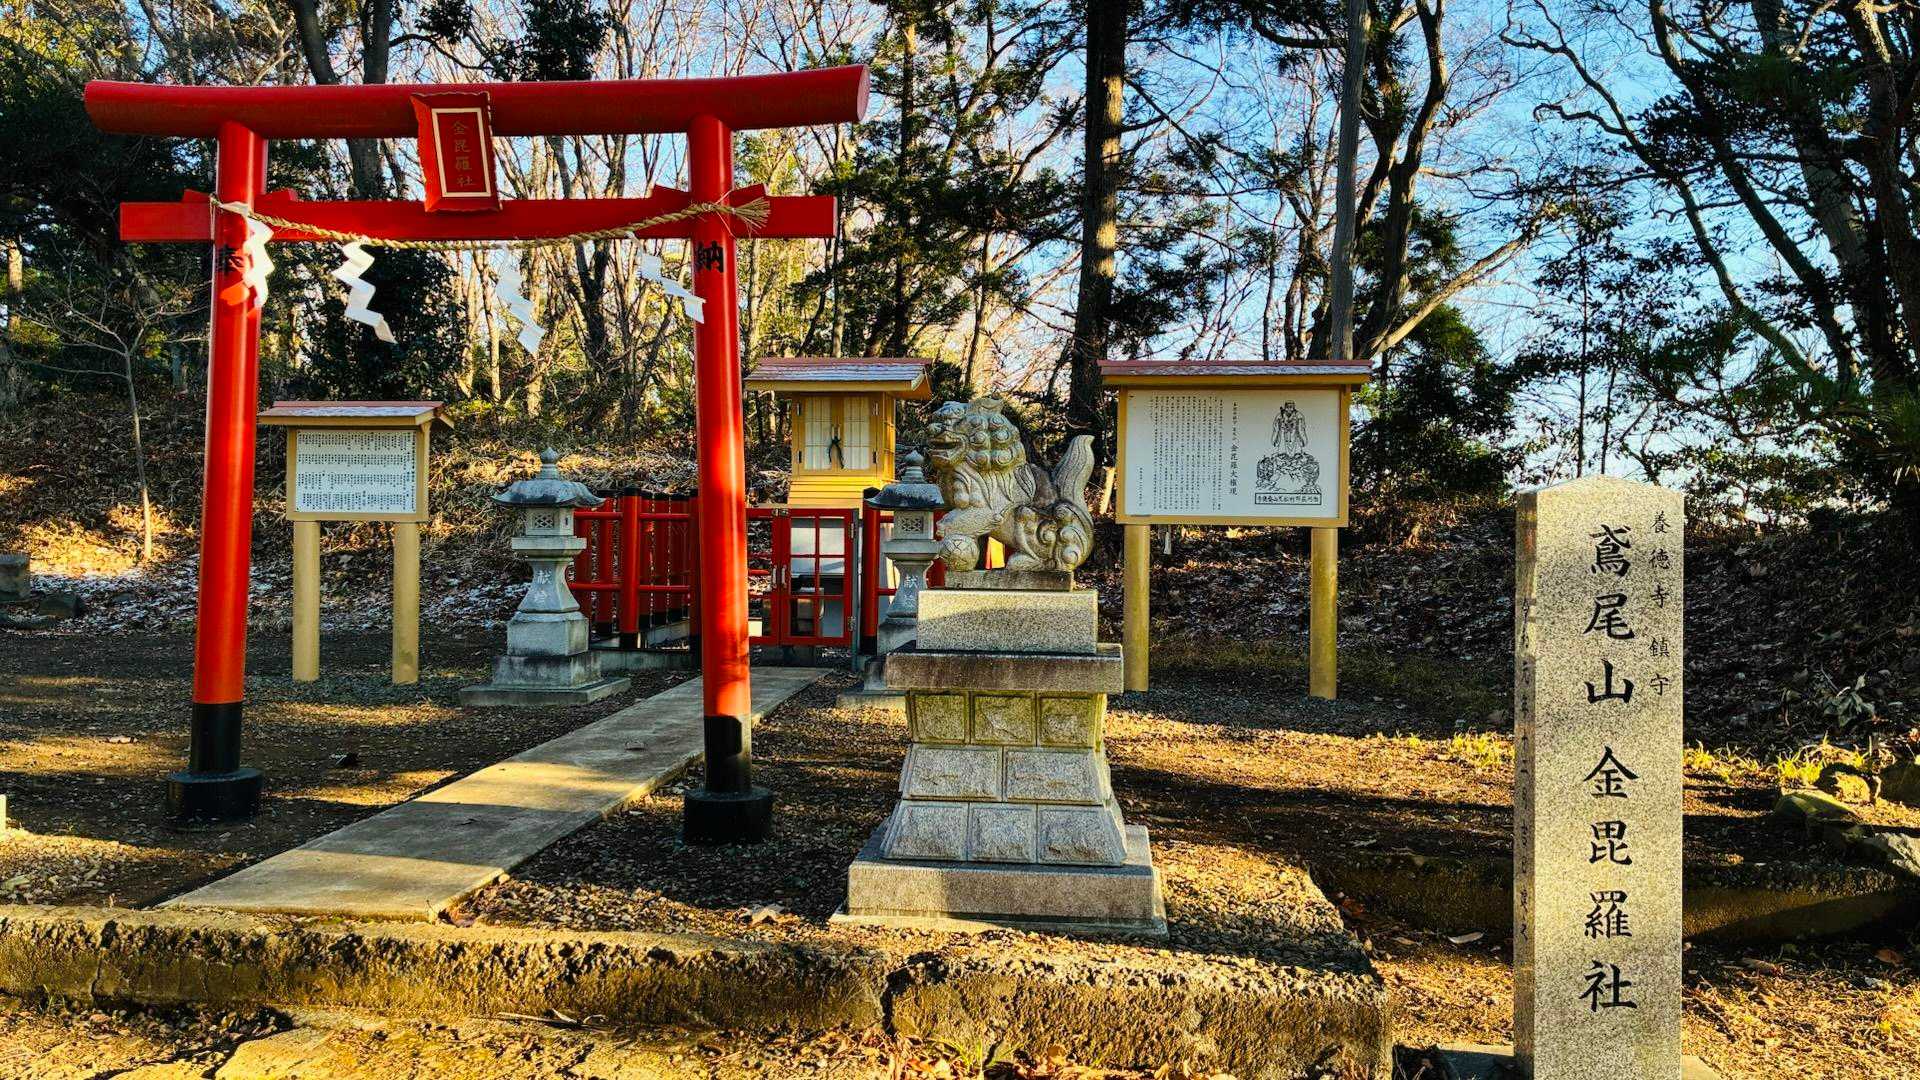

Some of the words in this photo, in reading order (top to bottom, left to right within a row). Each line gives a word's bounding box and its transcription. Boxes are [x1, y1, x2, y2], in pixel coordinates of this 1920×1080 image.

[695, 239, 725, 273] 納
[1649, 510, 1671, 697] 養徳寺鎮守
[1578, 523, 1639, 1013] 鳶尾山金毘羅社
